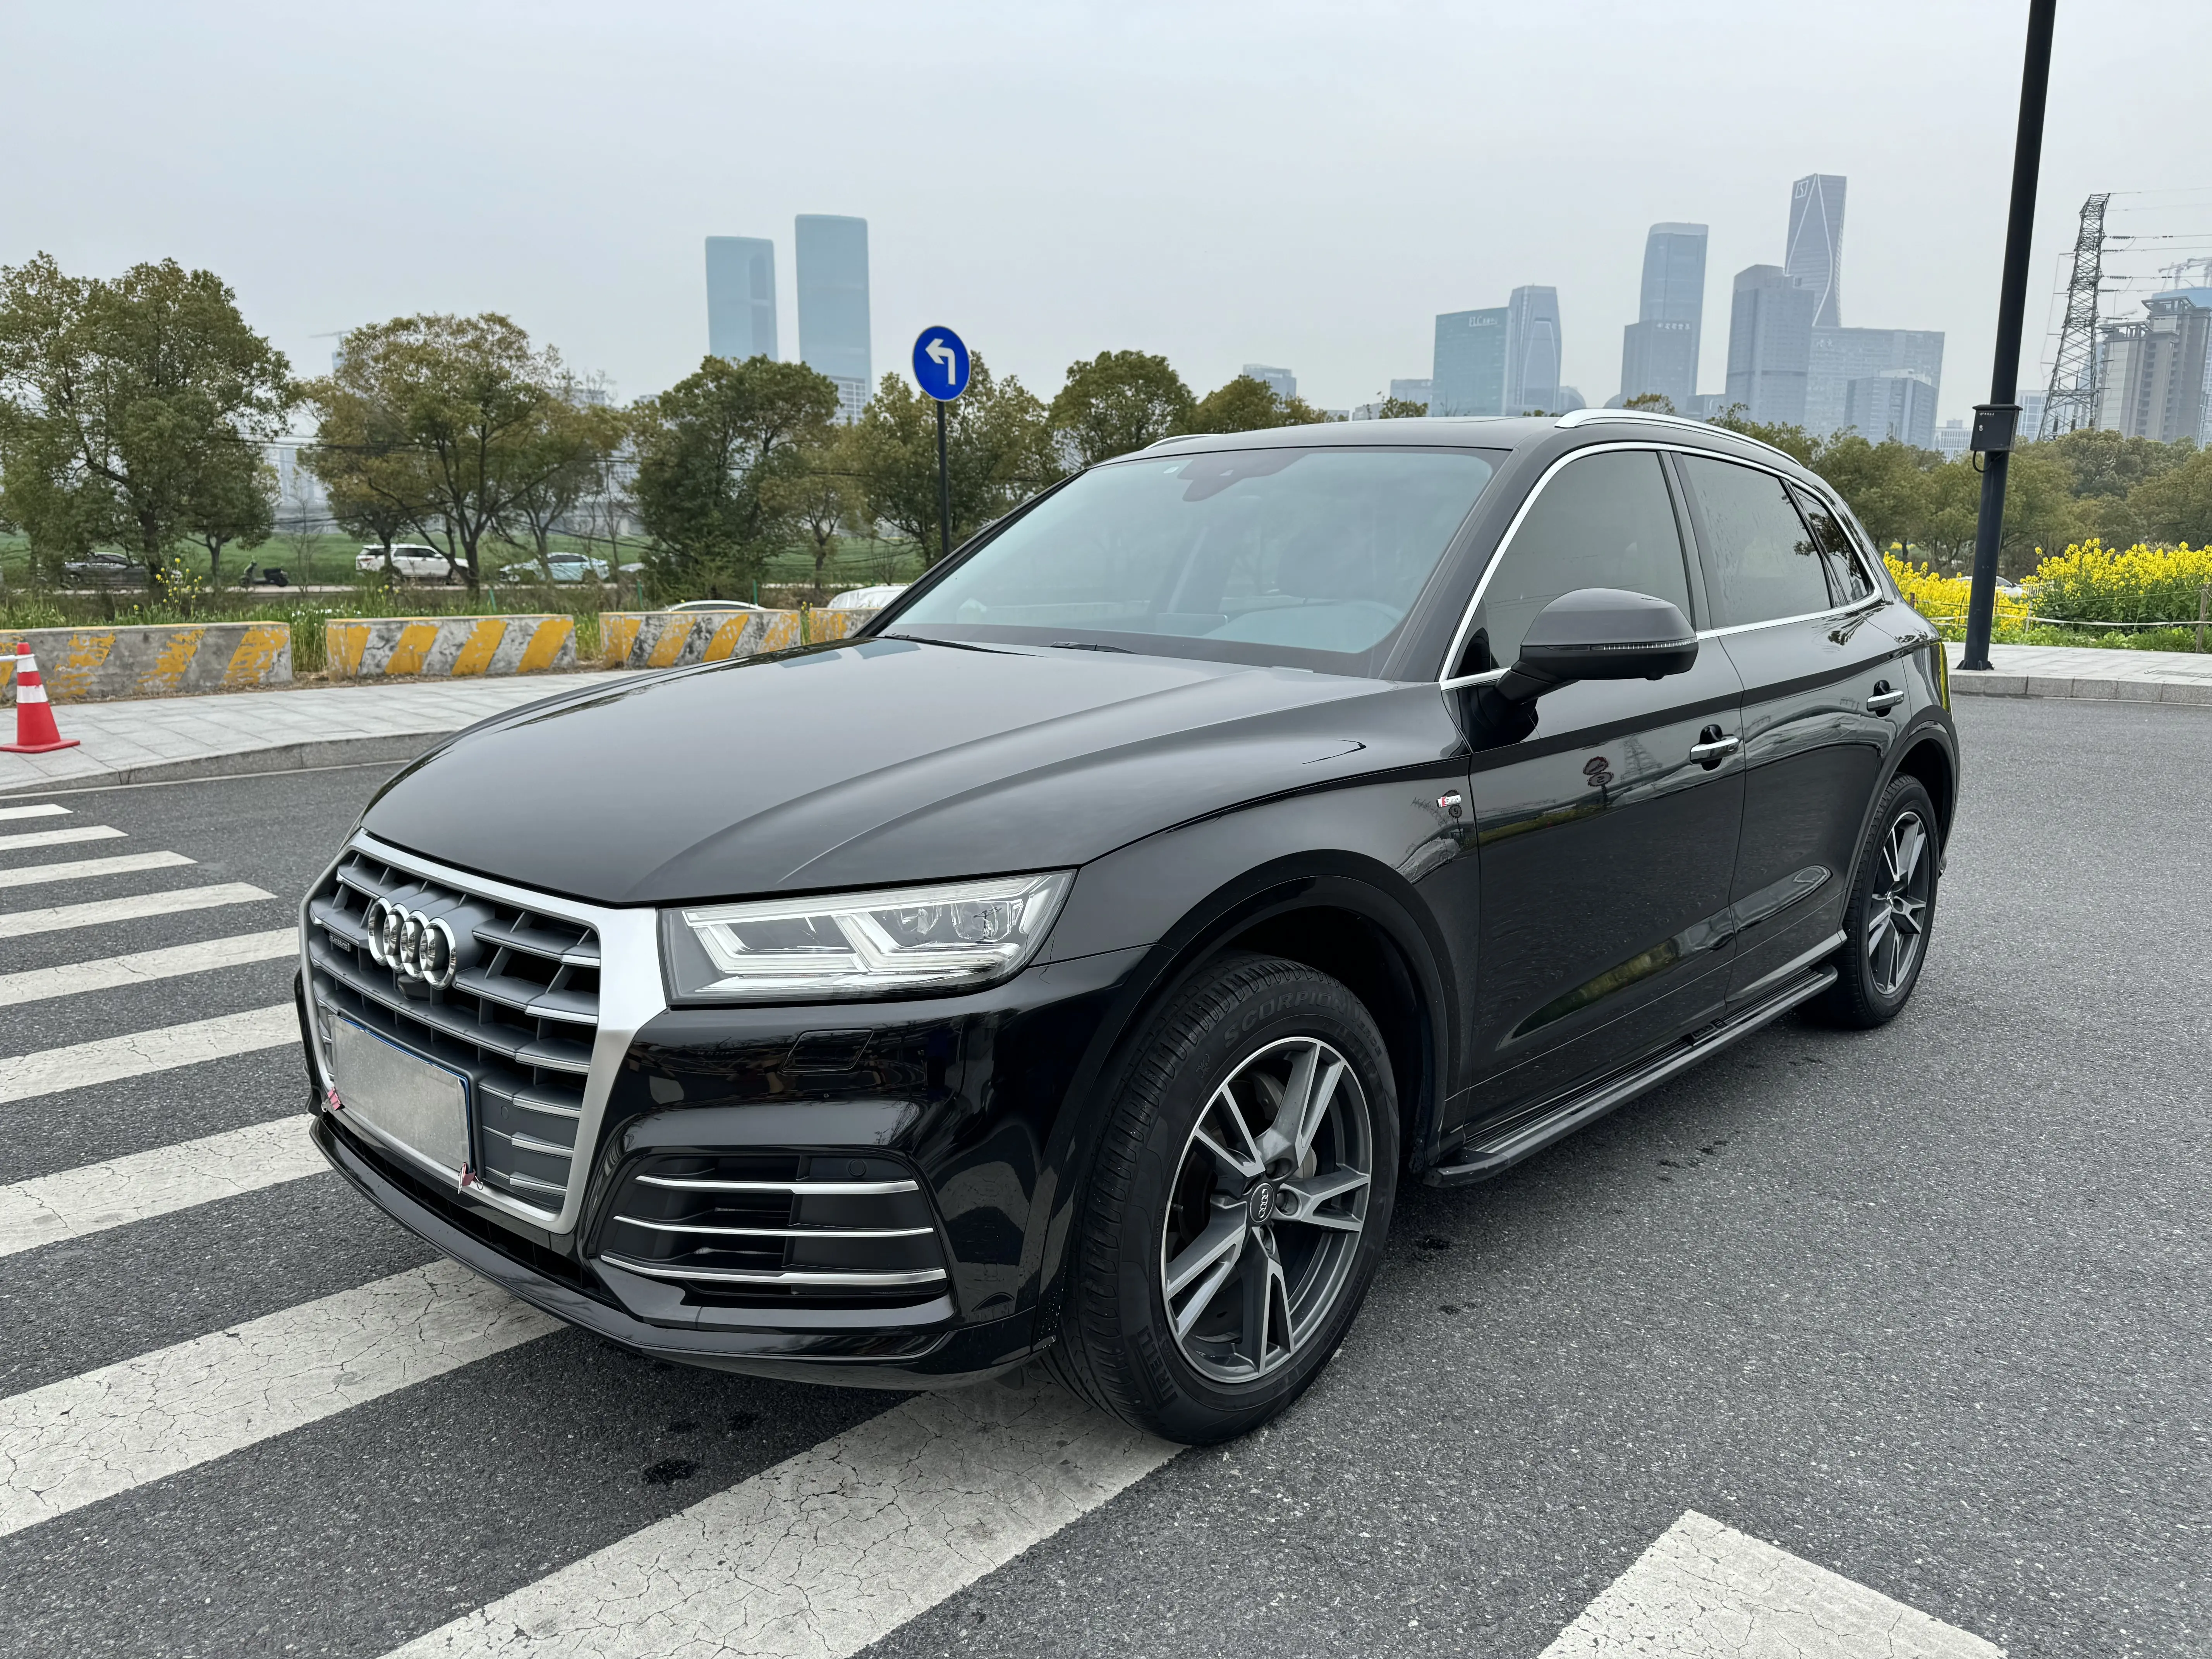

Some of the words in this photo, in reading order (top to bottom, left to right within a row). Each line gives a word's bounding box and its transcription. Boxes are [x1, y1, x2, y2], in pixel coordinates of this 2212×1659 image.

[329, 935, 348, 949] quattro
[1223, 991, 1347, 1049] SCORPION
[1127, 1324, 1179, 1411] PIRELLI
